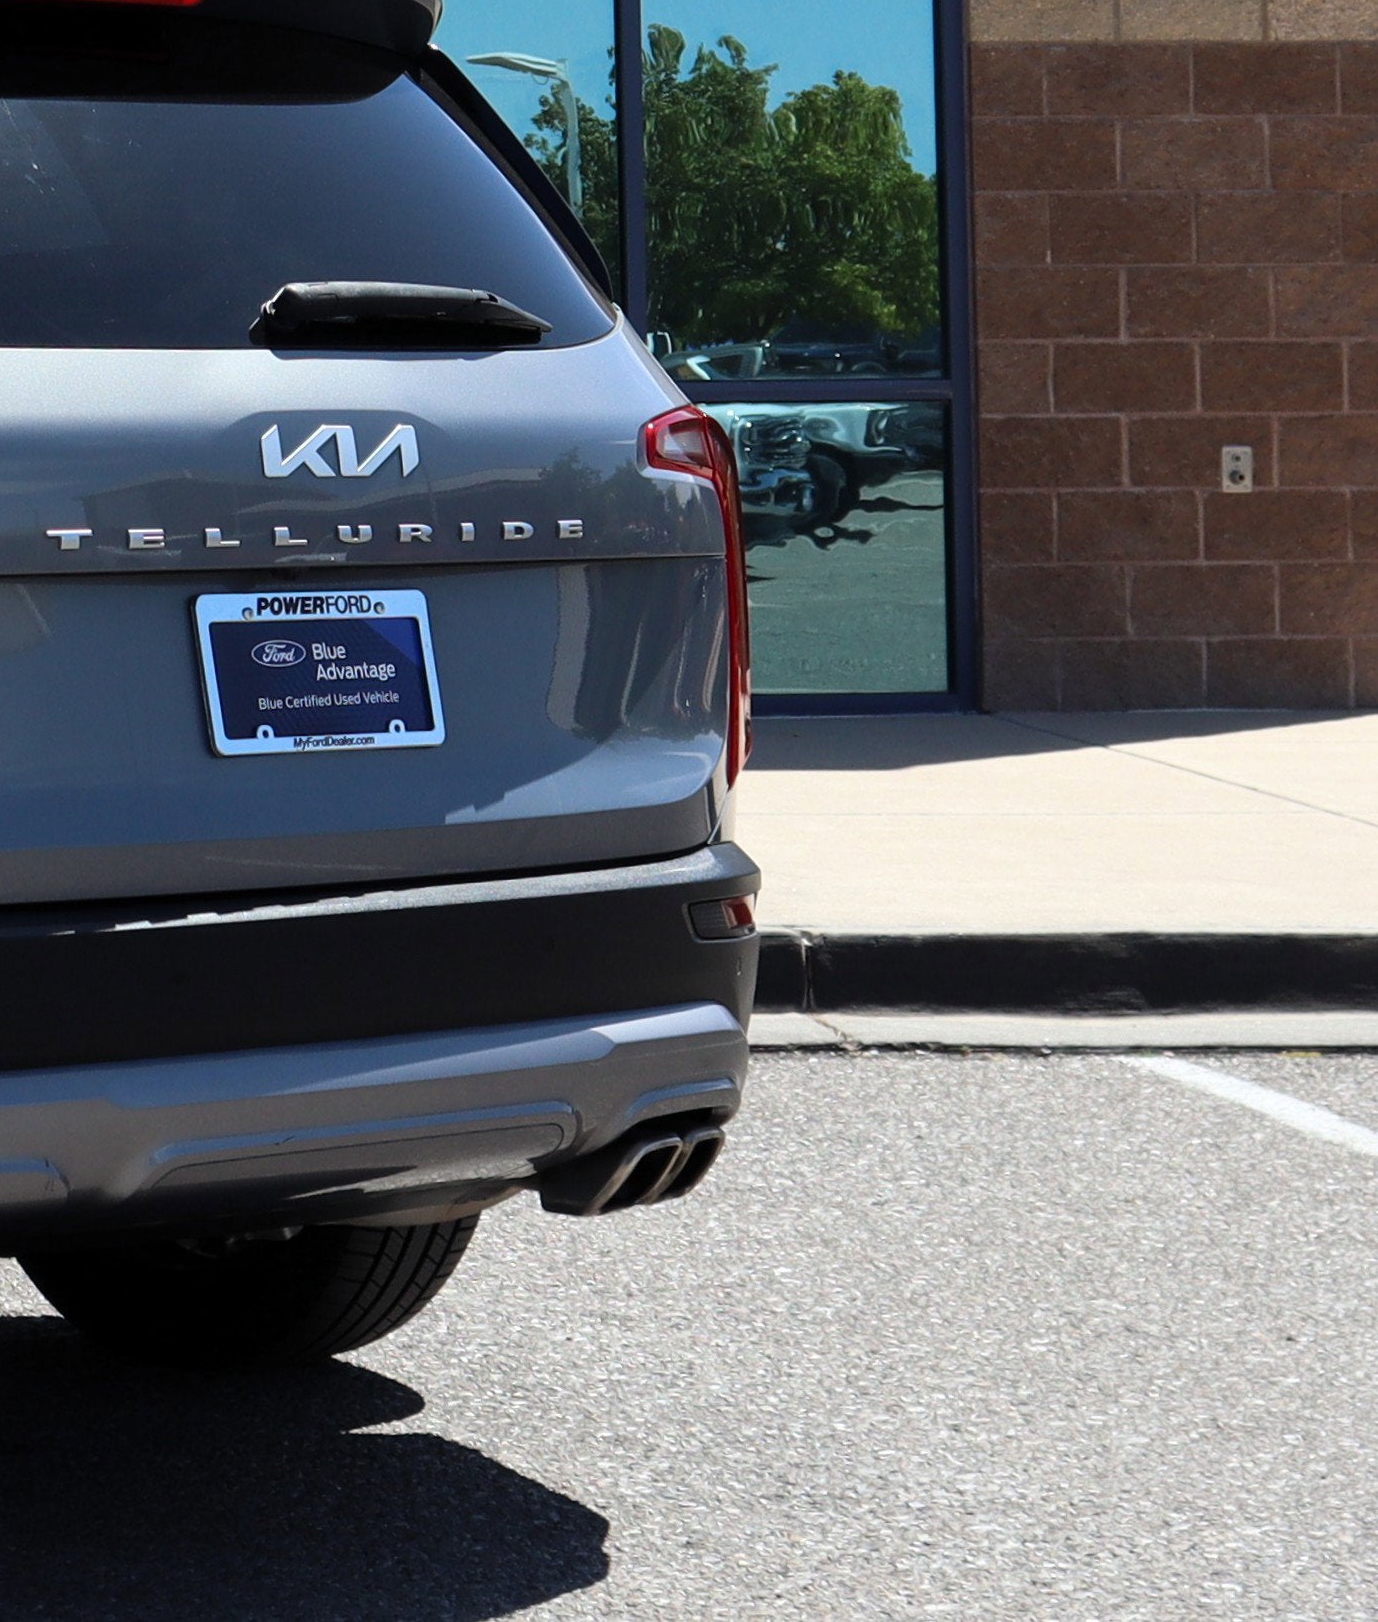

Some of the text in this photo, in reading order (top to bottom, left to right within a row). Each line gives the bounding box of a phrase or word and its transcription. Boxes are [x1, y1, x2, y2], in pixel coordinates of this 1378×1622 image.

[260, 423, 420, 478] KIA
[46, 518, 585, 551] TELLURIDE
[256, 595, 372, 616] POWERFORD
[262, 643, 296, 663] Ford
[311, 642, 346, 661] Blue
[316, 662, 396, 682] Advantage
[258, 690, 400, 710] Blue Certified Used Vehicle
[293, 735, 375, 751] MyFordDealer.com
